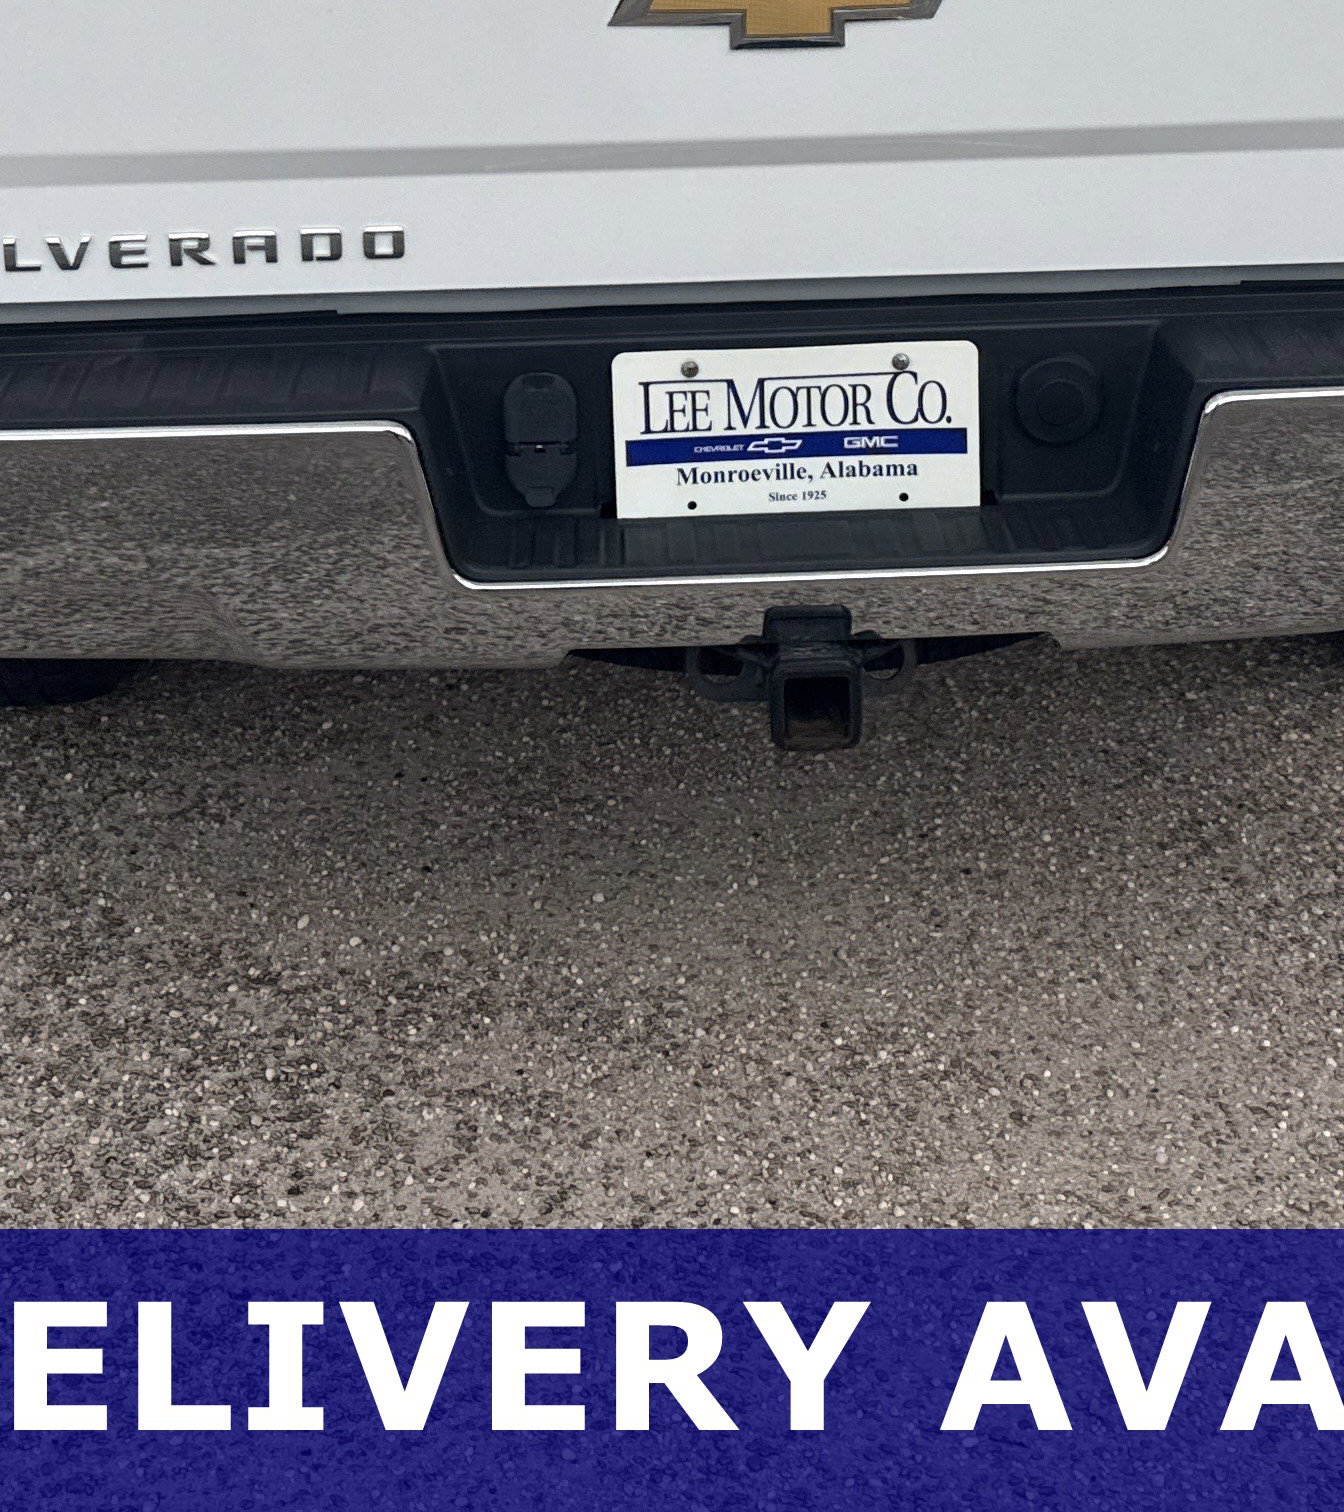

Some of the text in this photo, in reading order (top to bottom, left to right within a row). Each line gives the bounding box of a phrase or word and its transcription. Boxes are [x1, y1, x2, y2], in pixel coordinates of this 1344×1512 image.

[637, 370, 953, 435] LEE MOTOR CO.
[693, 443, 745, 454] CHEVROLET
[843, 435, 899, 449] GMC
[676, 460, 919, 487] Monroeville, Alabama
[768, 489, 828, 503] Since 1925
